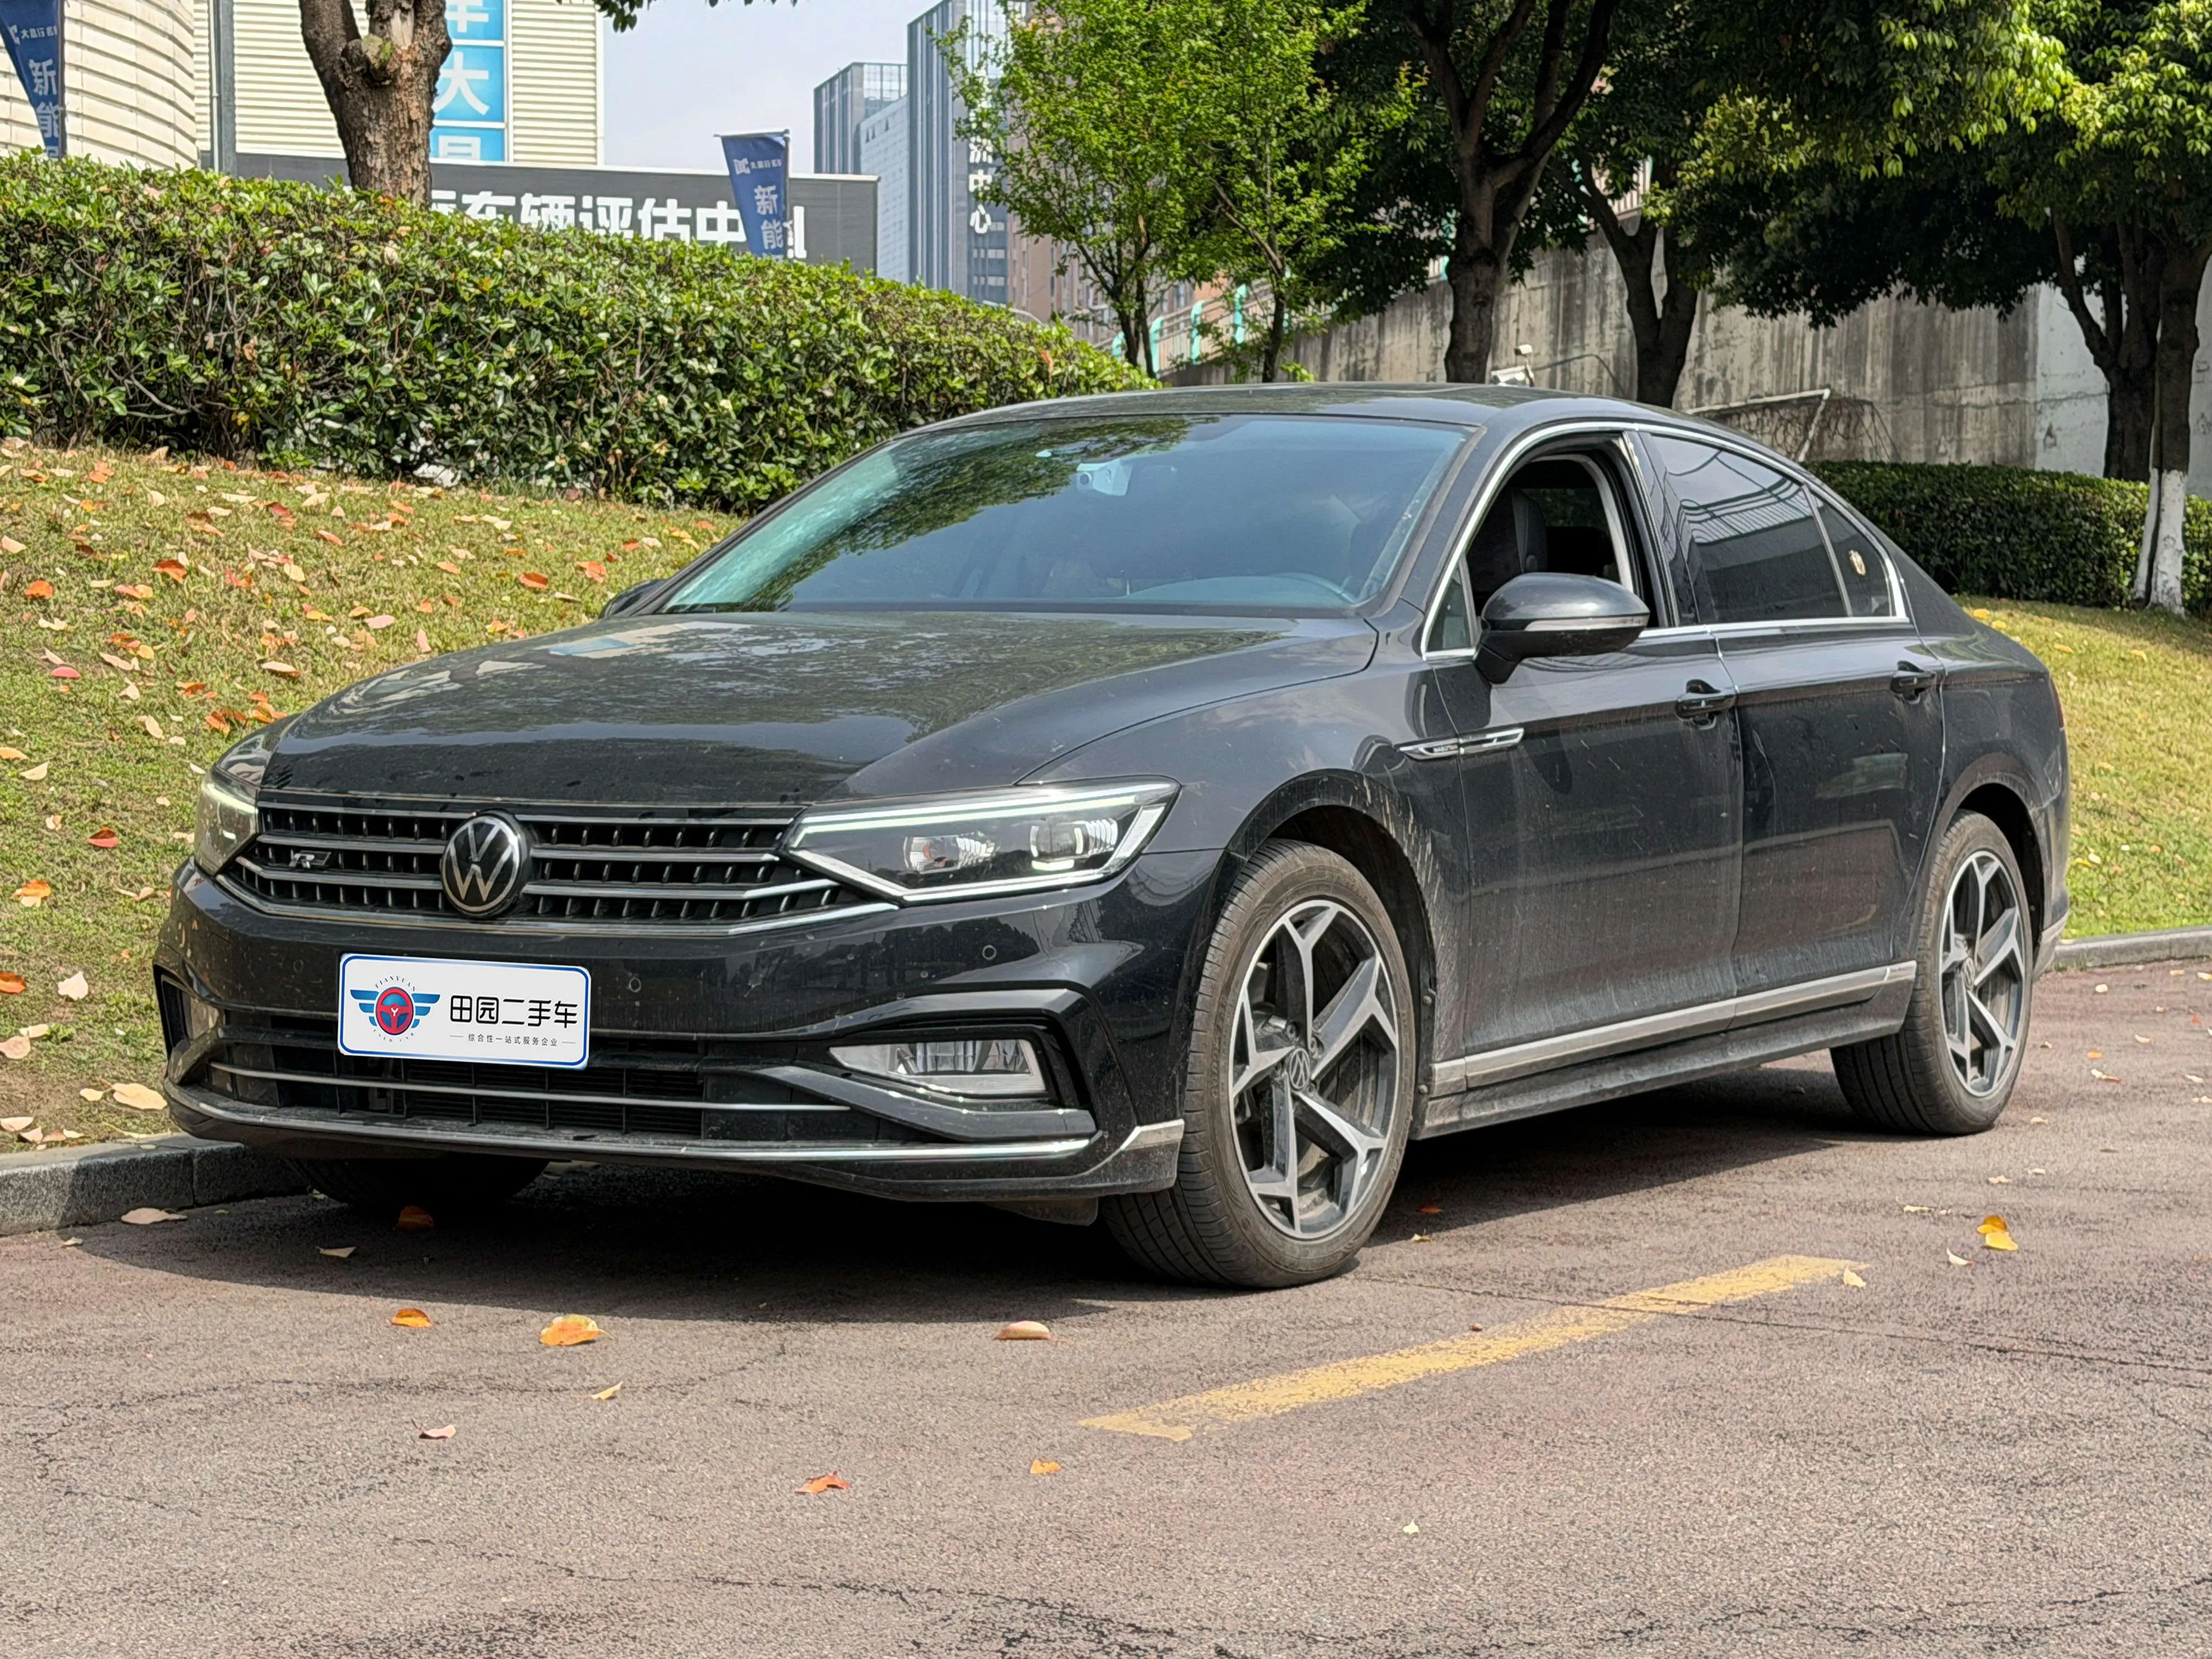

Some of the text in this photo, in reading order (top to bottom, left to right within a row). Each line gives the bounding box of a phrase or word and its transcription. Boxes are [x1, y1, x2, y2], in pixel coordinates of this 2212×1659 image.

[29, 58, 59, 158] 新能
[754, 184, 783, 262] 新能
[450, 995, 578, 1029] 田园二手车
[467, 1032, 558, 1047] 综合性一站式服务企业
